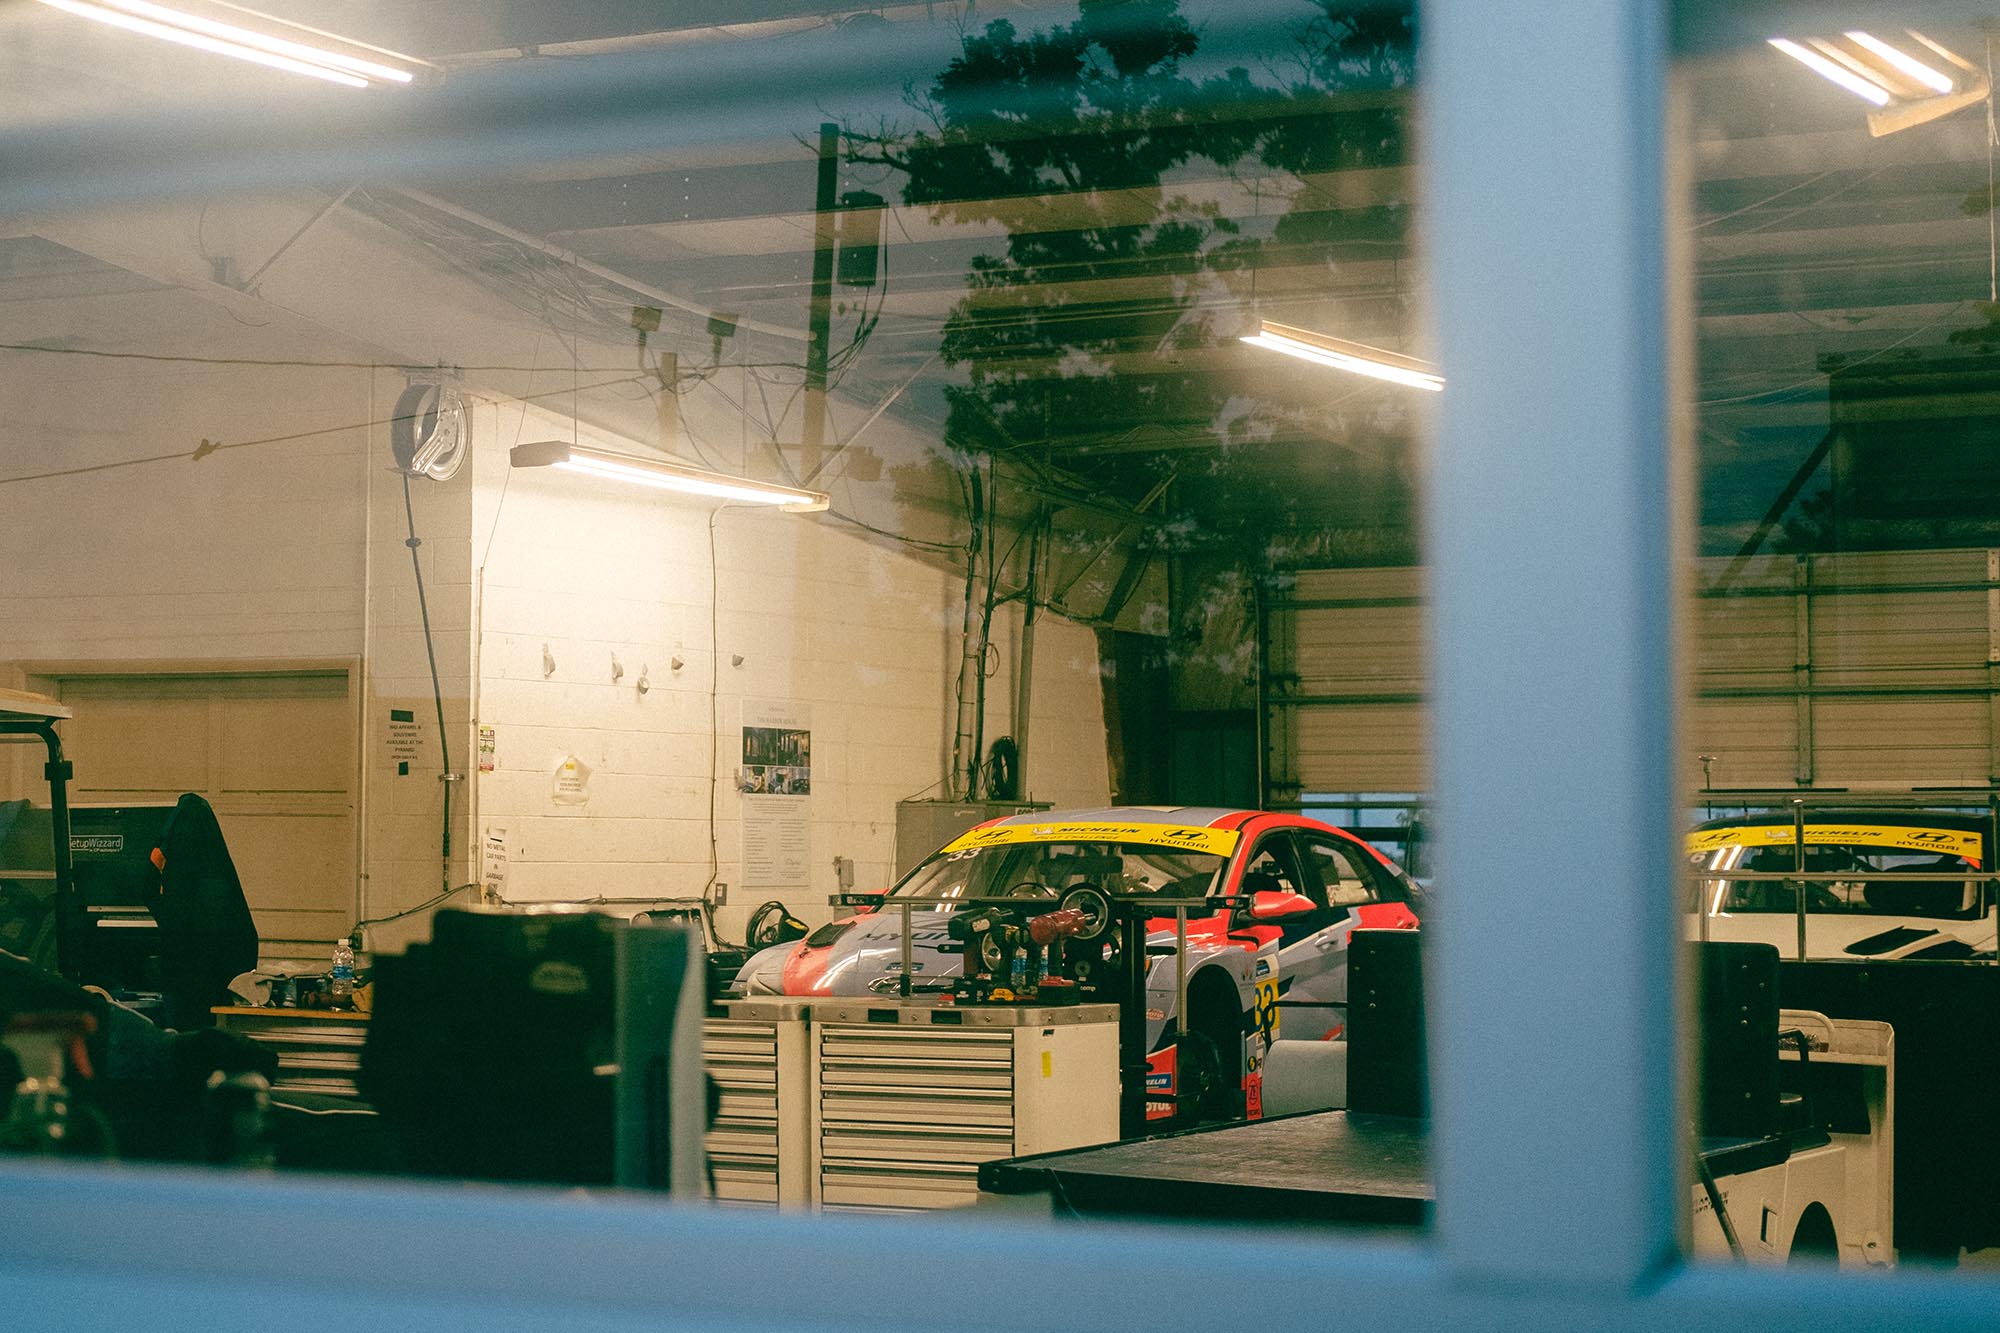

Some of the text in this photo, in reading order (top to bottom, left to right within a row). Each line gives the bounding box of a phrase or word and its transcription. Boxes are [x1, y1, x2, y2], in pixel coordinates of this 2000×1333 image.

[71, 838, 121, 848] etupWizzard
[958, 838, 1010, 848] HYUNDAI
[1149, 838, 1209, 848] HYUNDAI
[1896, 841, 1960, 851] HYUNDAI
[947, 848, 983, 862] 33
[1146, 1102, 1172, 1111] OTUL
